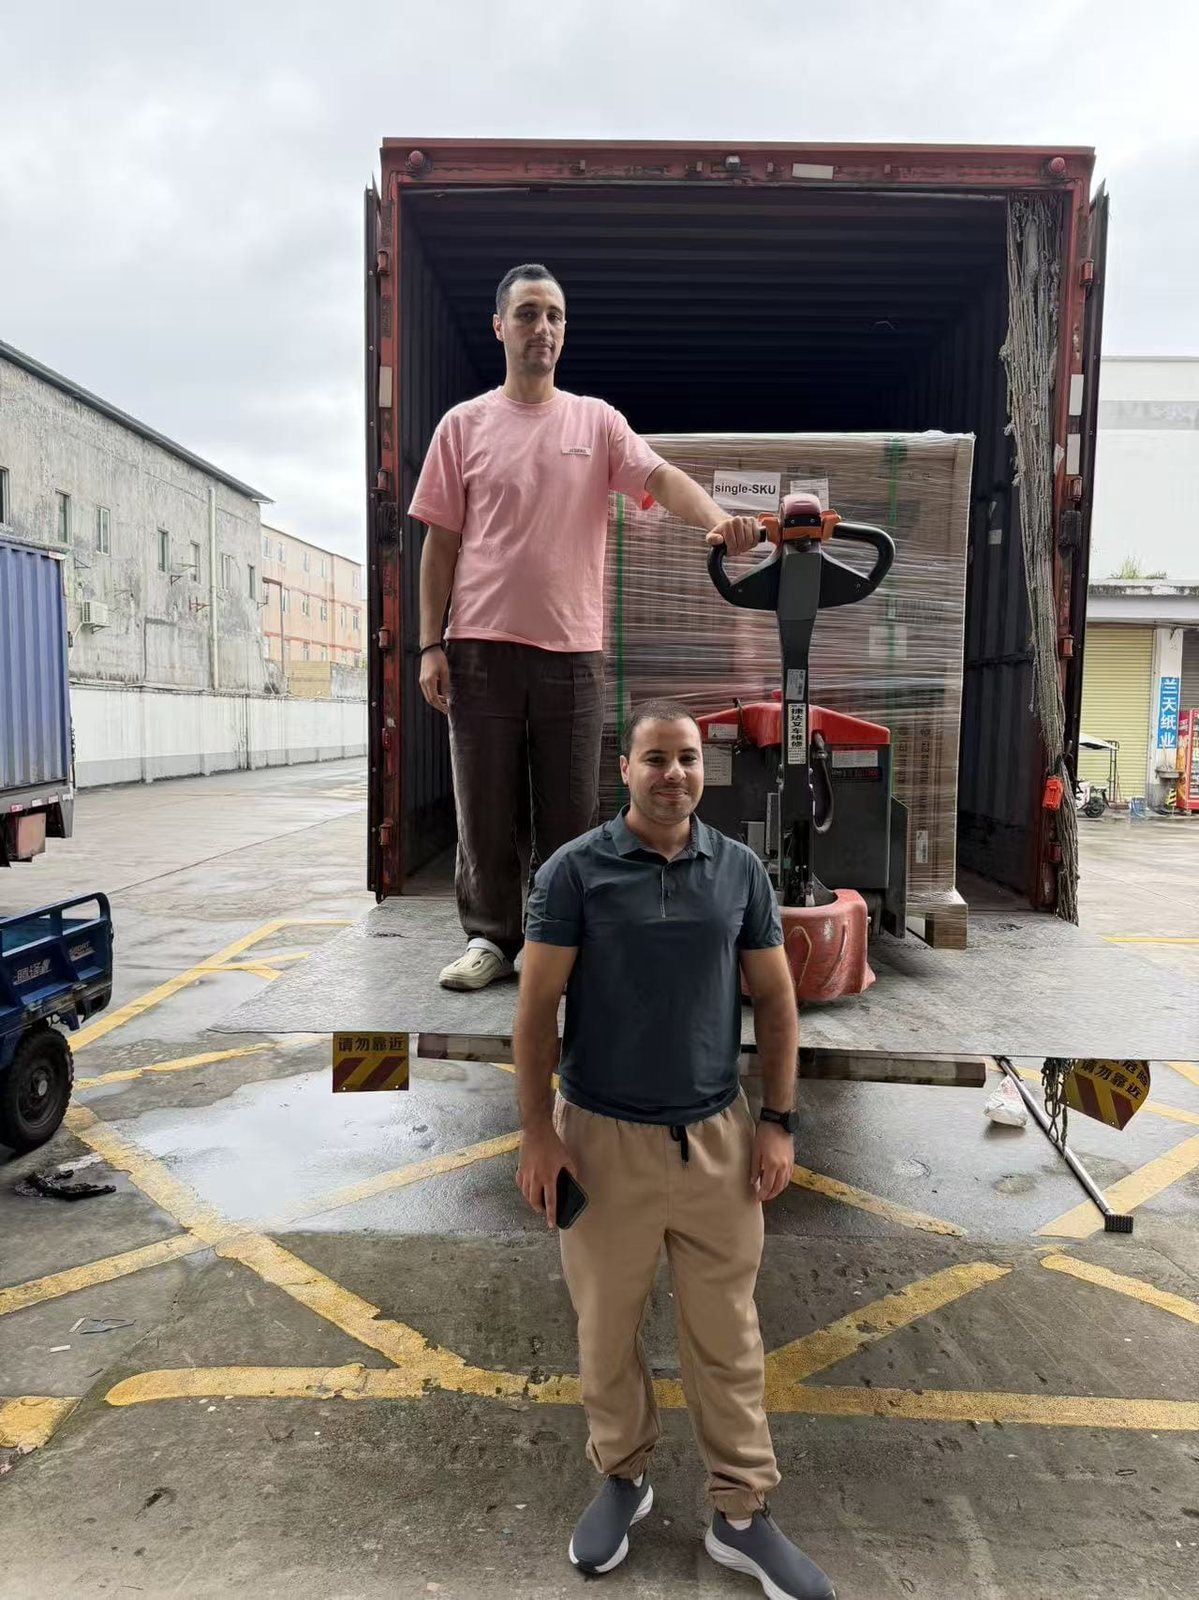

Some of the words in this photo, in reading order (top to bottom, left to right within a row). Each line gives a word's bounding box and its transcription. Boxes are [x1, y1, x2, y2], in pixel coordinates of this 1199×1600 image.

[714, 483, 776, 496] single-SKU
[339, 1036, 404, 1052] 请勿靠近
